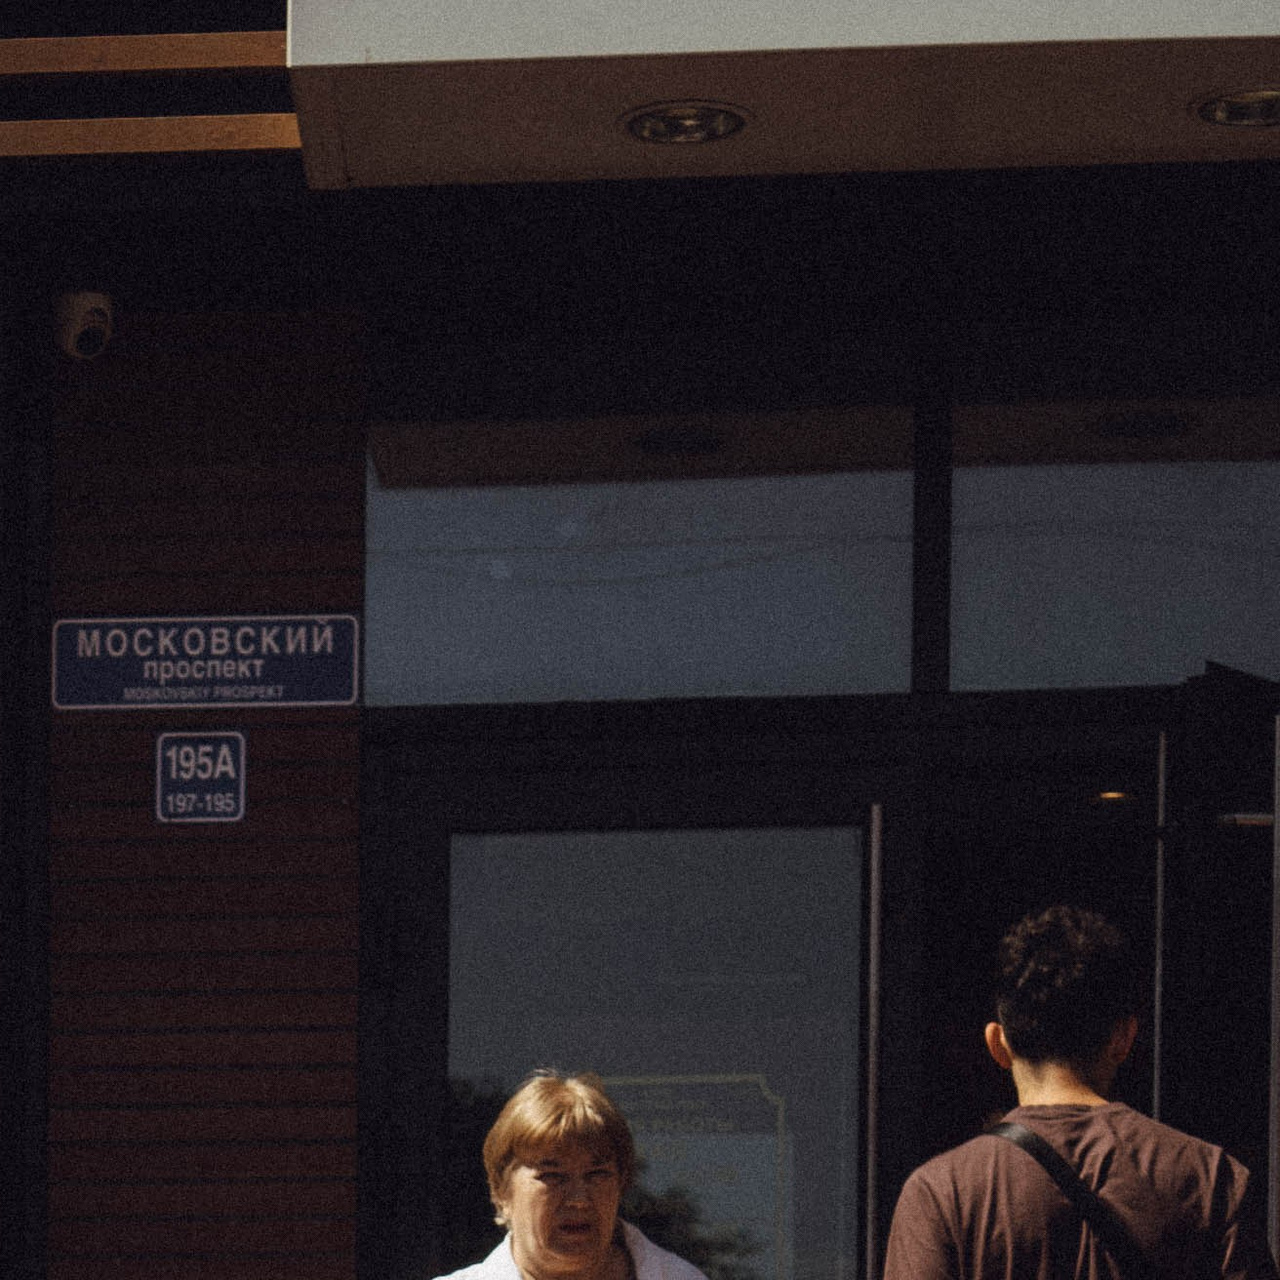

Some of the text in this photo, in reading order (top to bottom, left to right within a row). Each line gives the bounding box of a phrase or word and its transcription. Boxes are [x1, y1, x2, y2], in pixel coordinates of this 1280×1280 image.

[76, 621, 334, 657] МОСКОВСКИЙ
[143, 658, 266, 684] проспект
[166, 744, 237, 780] 195А
[166, 792, 237, 813] 197-195
